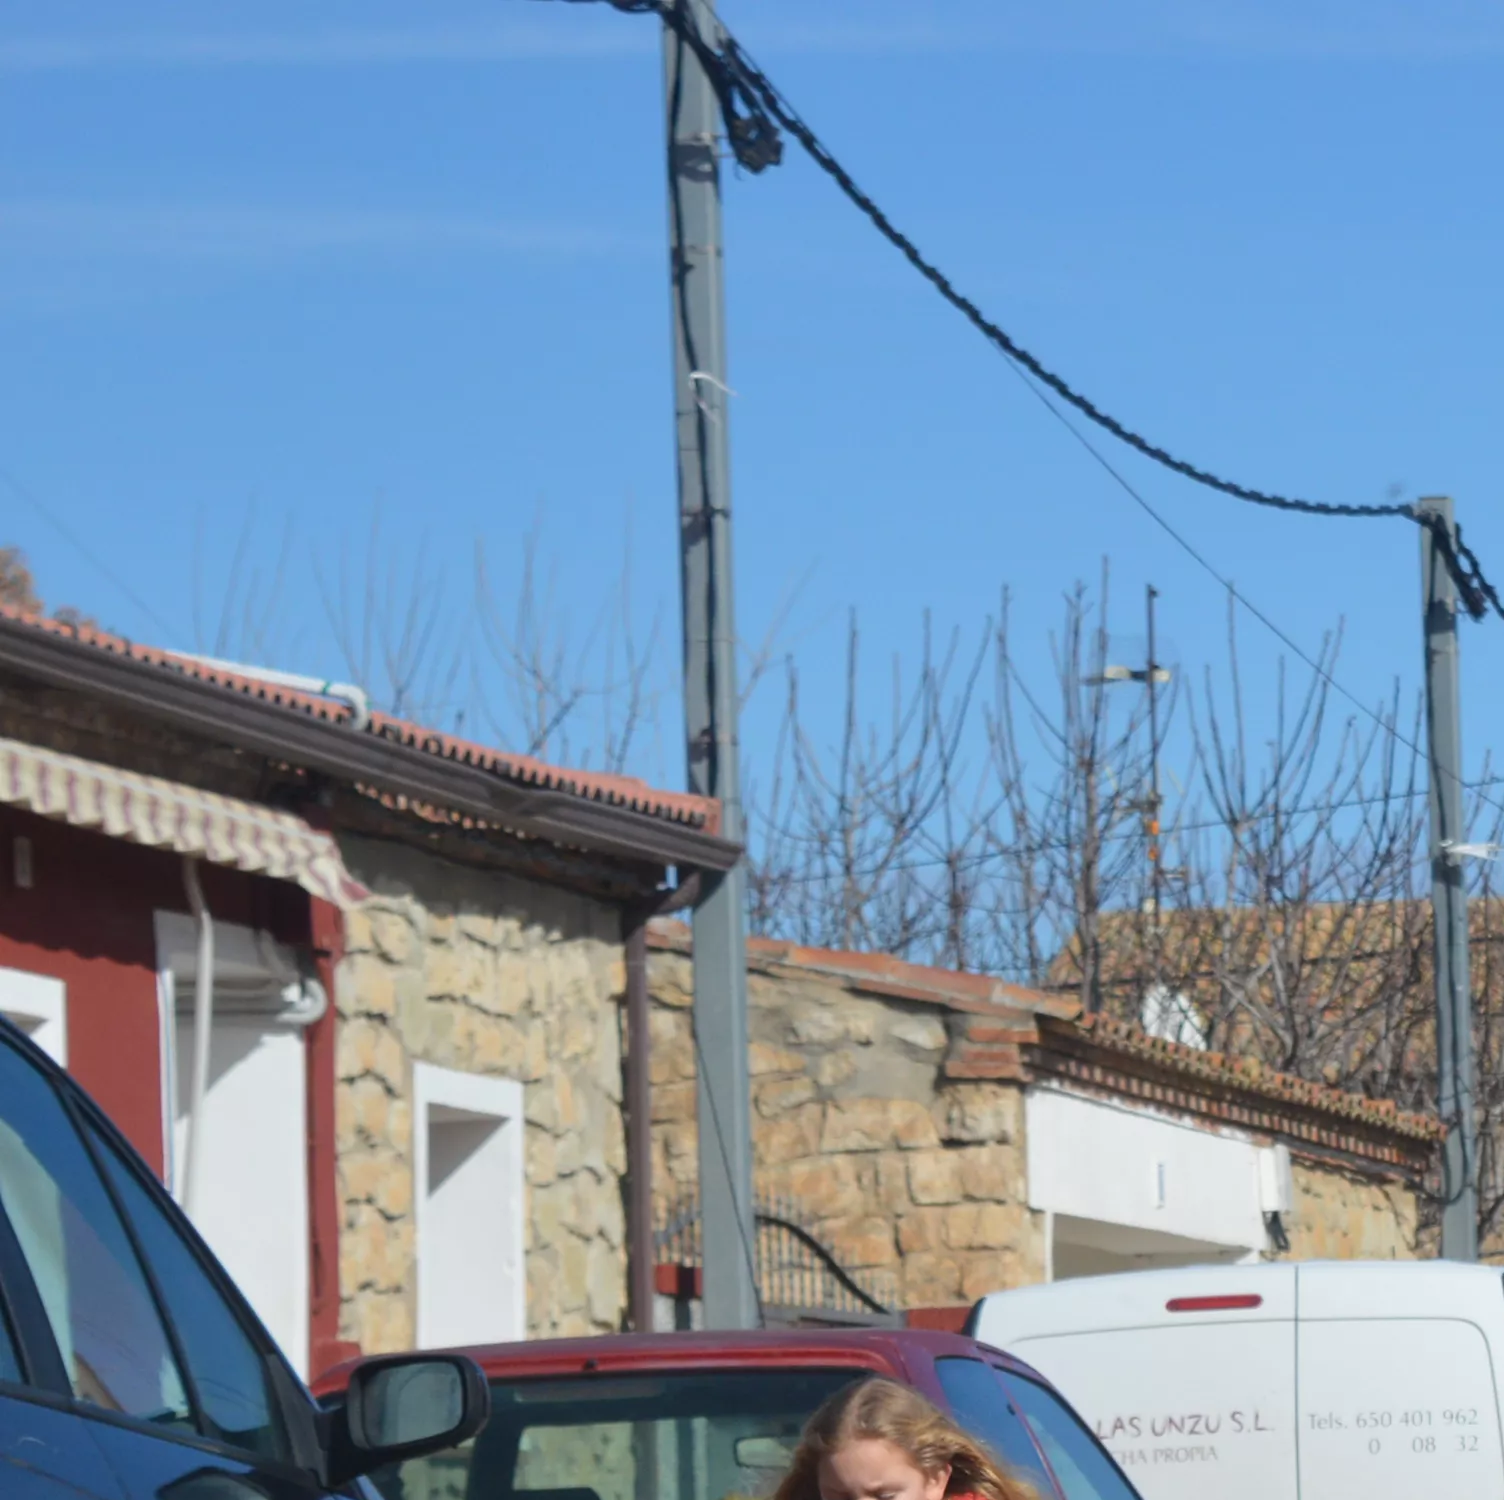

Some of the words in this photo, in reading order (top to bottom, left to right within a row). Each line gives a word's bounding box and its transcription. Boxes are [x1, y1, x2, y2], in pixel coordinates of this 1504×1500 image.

[1151, 1413, 1222, 1437] UNZU
[1308, 1412, 1348, 1430] Tels.
[1355, 1411, 1393, 1429] 650
[1399, 1410, 1433, 1427] 401
[1442, 1408, 1479, 1426] 962
[1455, 1435, 1480, 1452] 32
[1152, 1445, 1220, 1464] PROPIA
